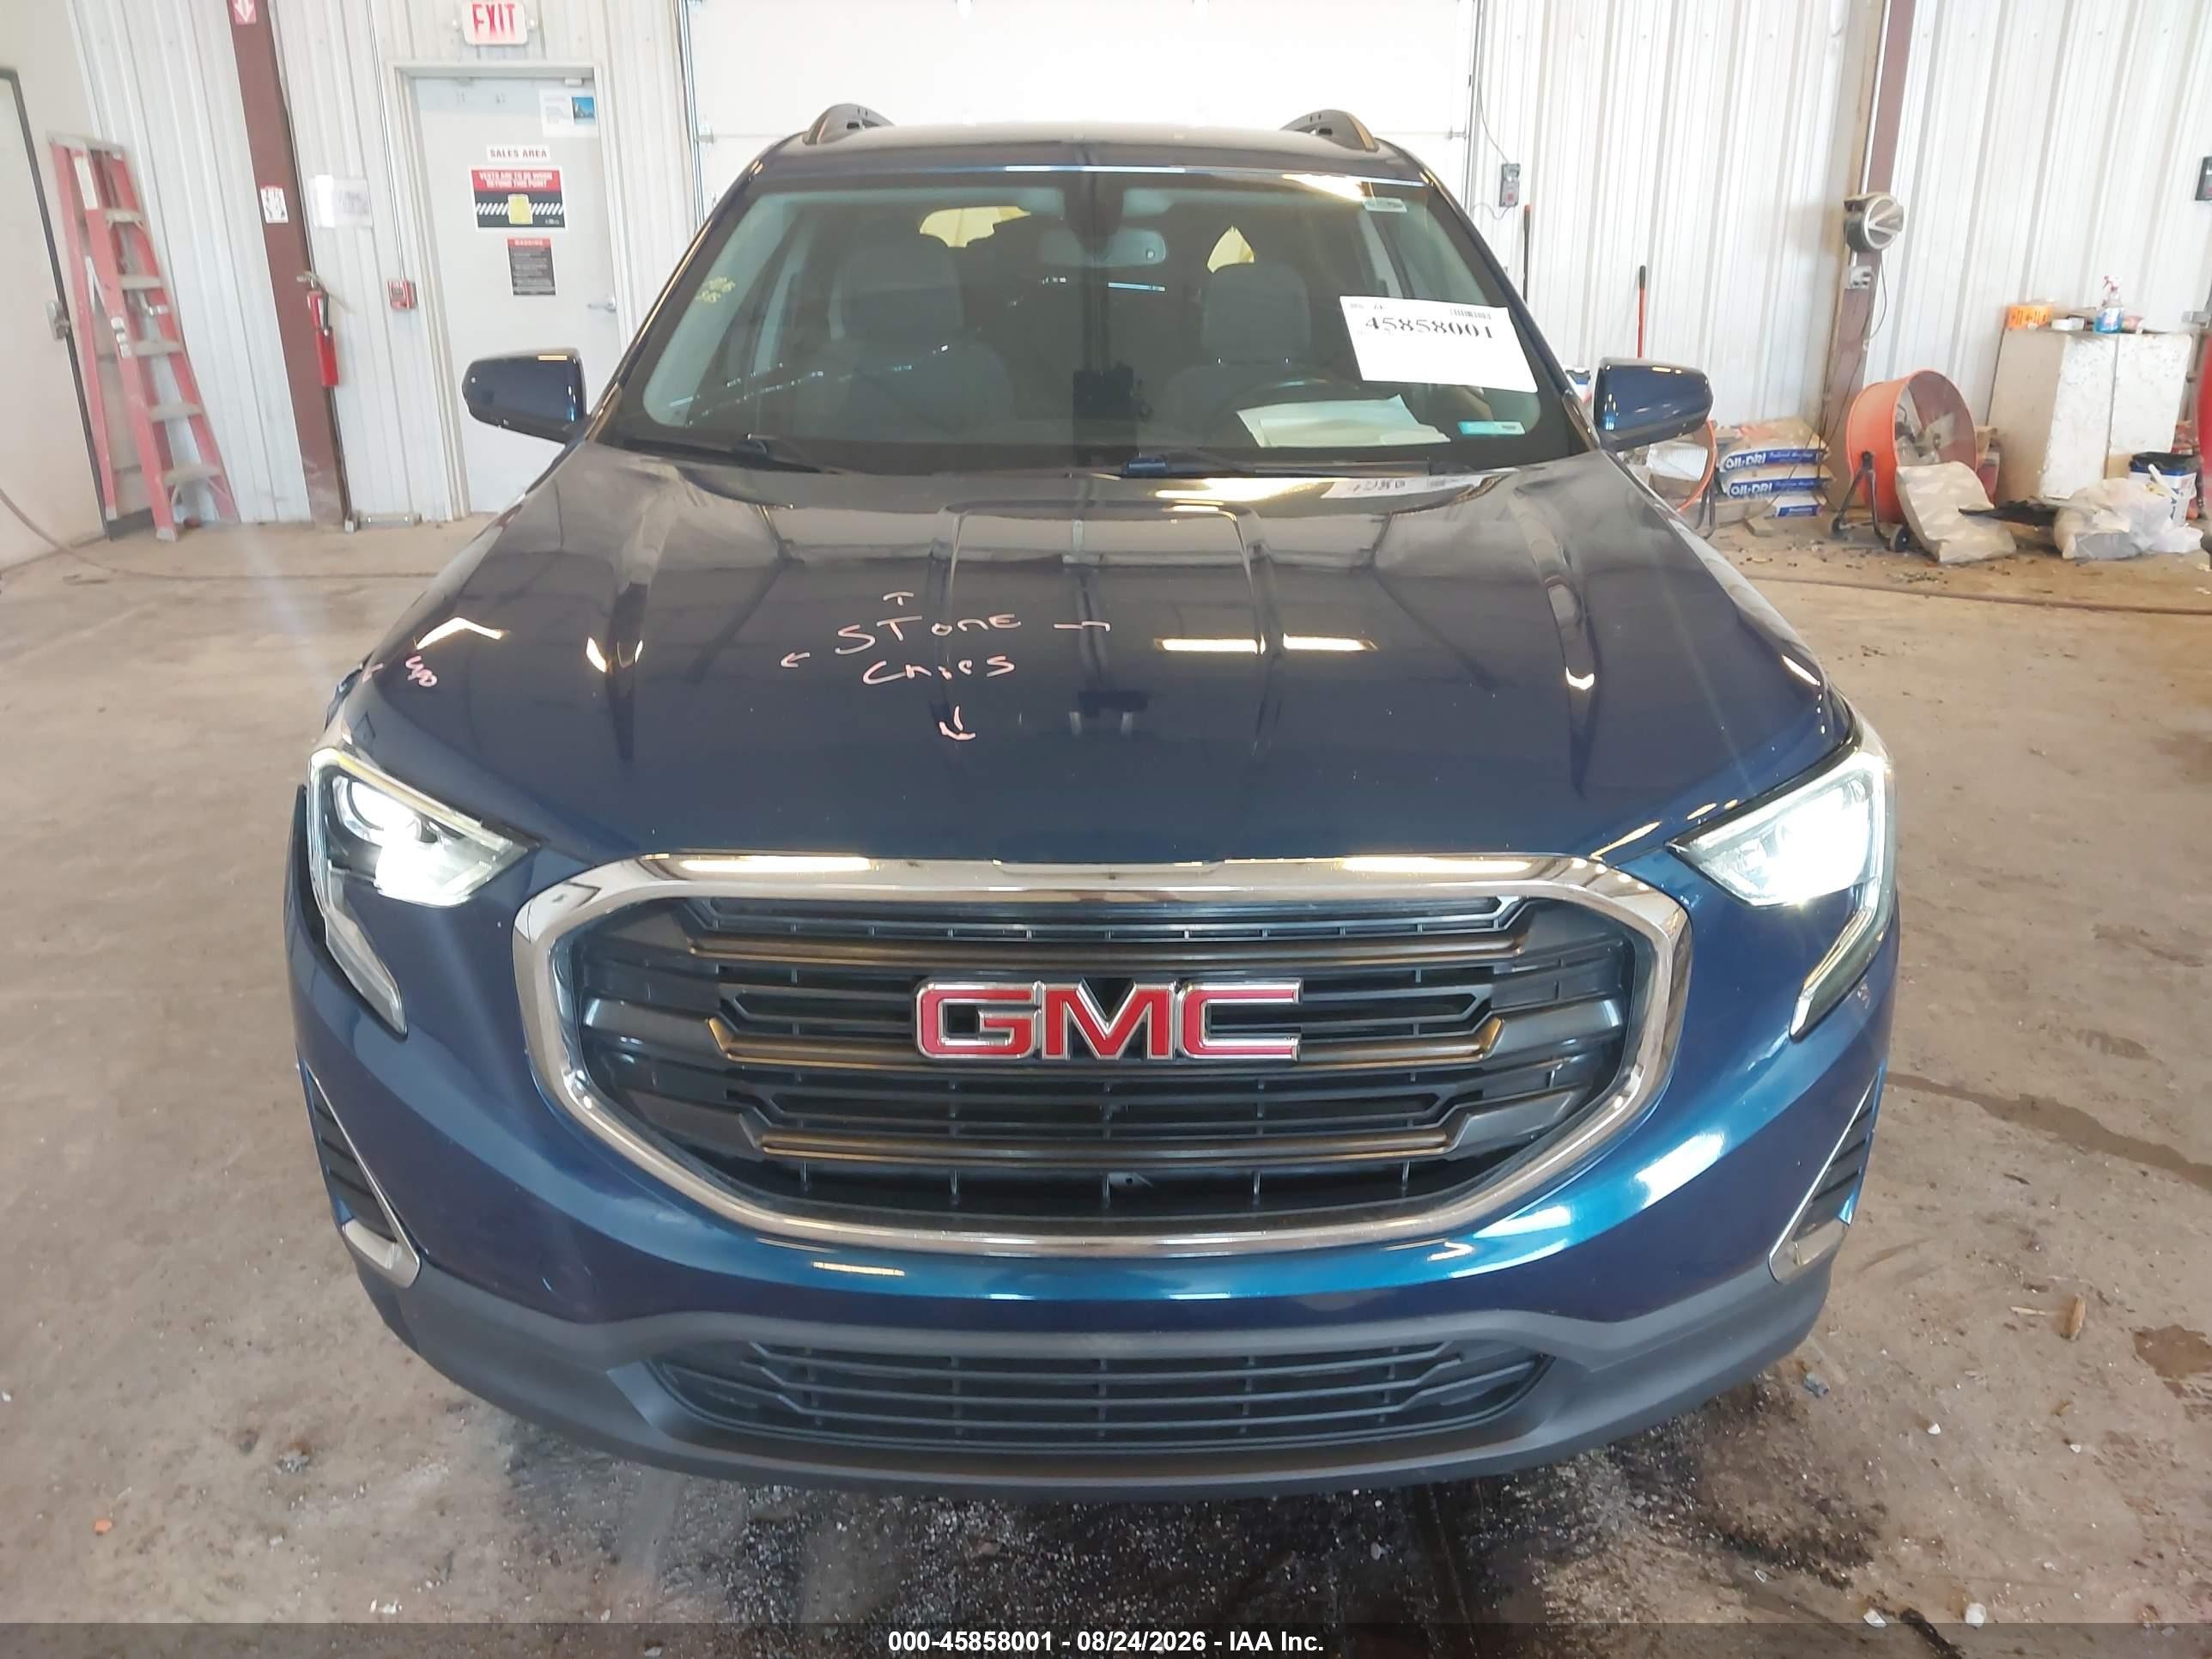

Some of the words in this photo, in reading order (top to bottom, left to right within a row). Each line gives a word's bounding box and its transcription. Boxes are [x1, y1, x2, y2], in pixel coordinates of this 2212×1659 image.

[472, 3, 515, 37] EXIT
[489, 149, 520, 158] SALES
[522, 149, 547, 158] AREA
[1365, 316, 1492, 338] 45858001
[915, 980, 1303, 1061] GMC
